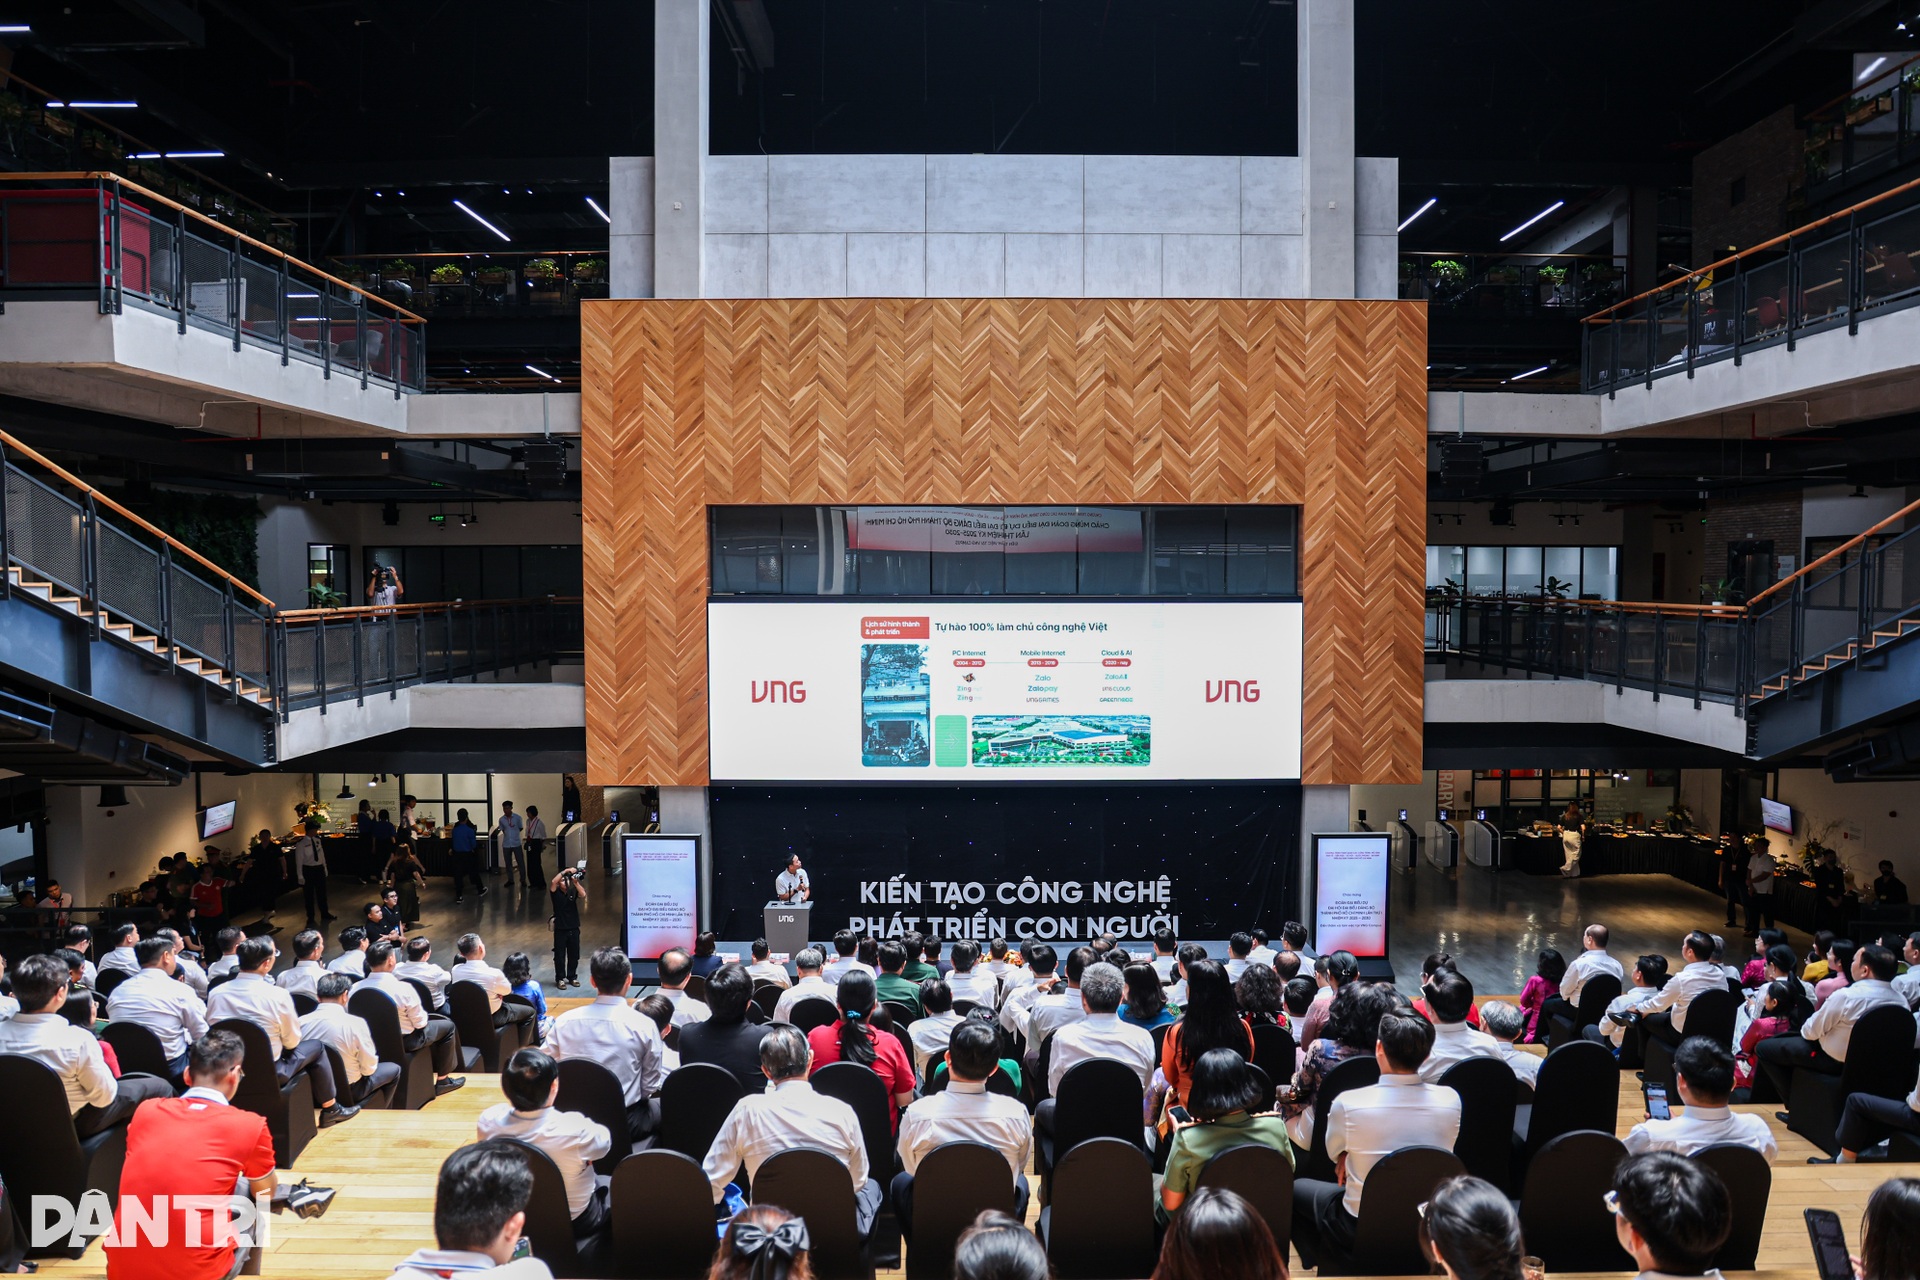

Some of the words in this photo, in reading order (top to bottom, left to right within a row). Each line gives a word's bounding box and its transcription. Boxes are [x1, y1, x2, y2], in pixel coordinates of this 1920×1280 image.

[935, 623, 948, 632] Tự
[949, 623, 966, 631] hào
[969, 623, 994, 631] 100%
[997, 623, 1014, 631] làm
[1036, 622, 1060, 633] công
[1062, 622, 1086, 633] nghệ
[1088, 622, 1107, 632] Việt
[752, 680, 806, 703] VNG
[1206, 680, 1260, 703] VNG
[1438, 770, 1454, 810] RARY
[860, 874, 922, 904] KIẾN
[930, 881, 986, 910] TẠO
[996, 876, 1082, 904] CÔNG
[1093, 875, 1171, 910] NGHỆ
[850, 911, 920, 939] PHÁT
[928, 908, 1006, 939] TRIỂN
[1015, 916, 1078, 939] CON
[1087, 913, 1179, 939] NGƯỜI
